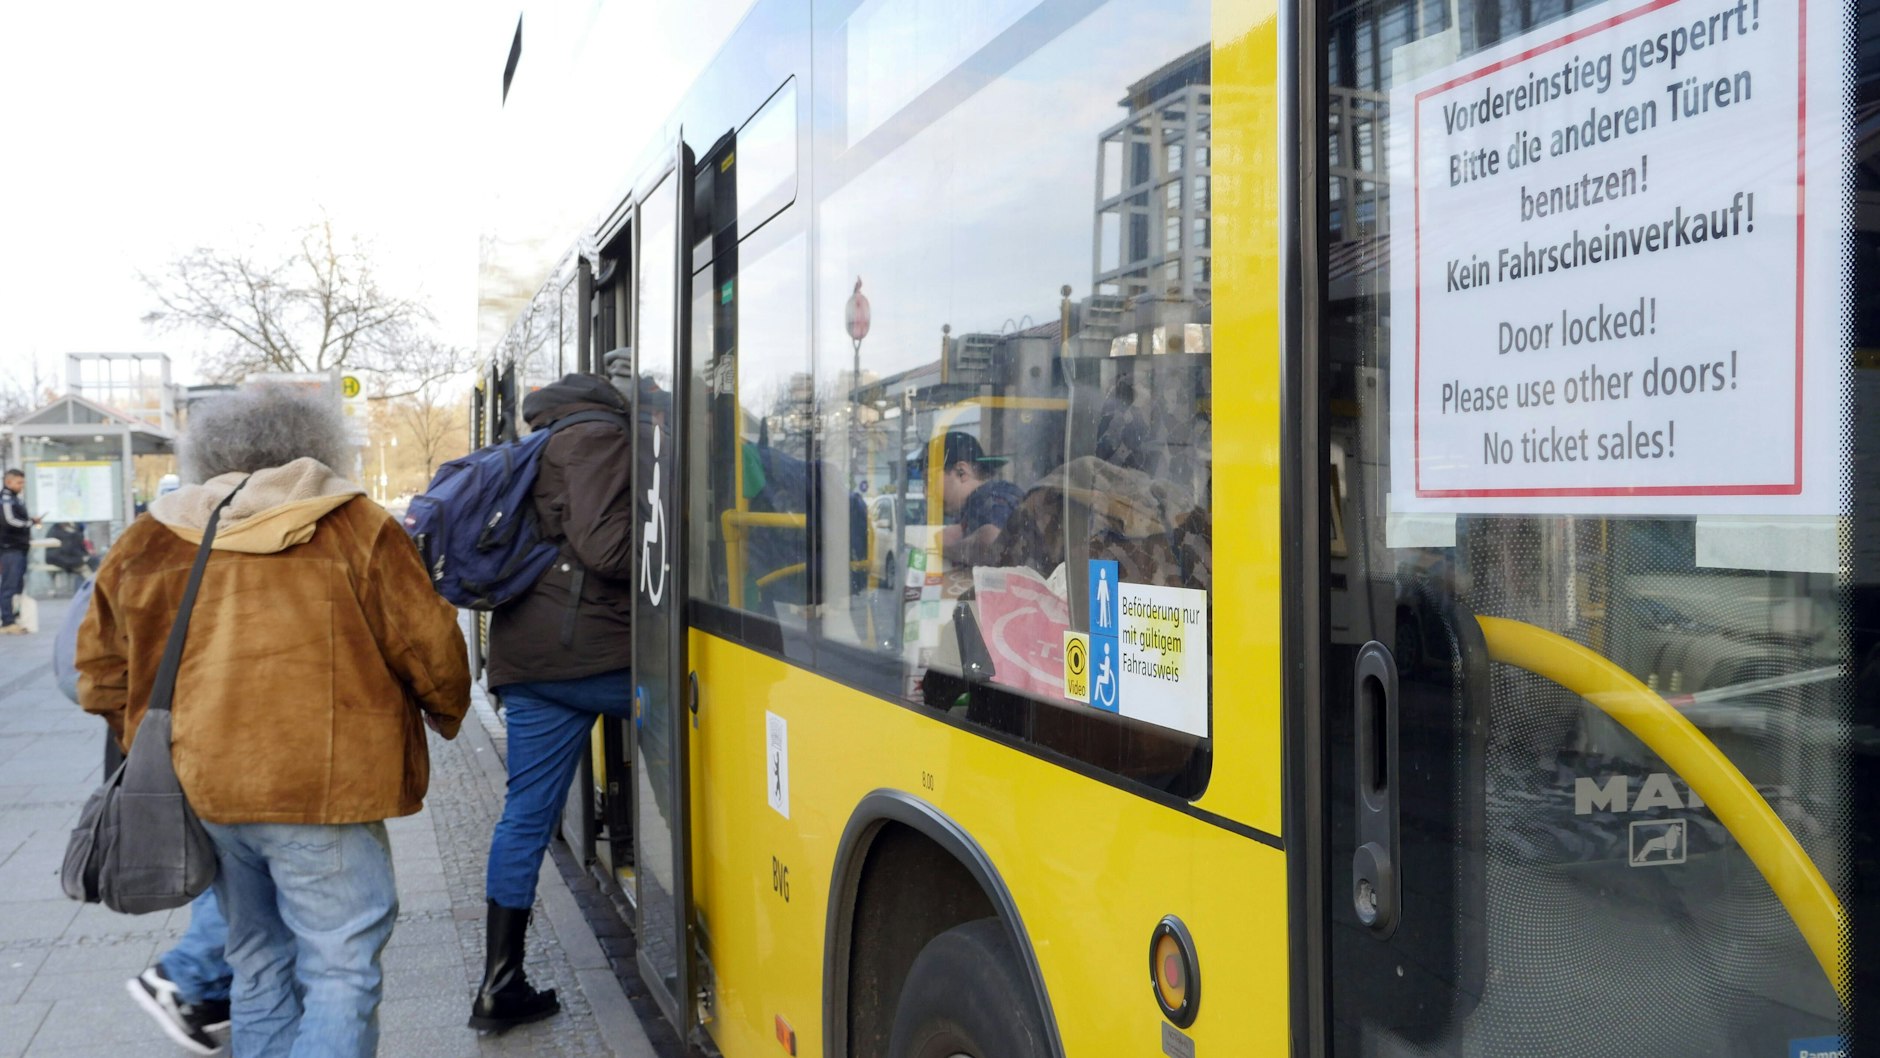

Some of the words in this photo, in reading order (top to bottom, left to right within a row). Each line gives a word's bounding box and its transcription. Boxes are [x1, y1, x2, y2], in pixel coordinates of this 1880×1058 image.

[1443, 52, 1612, 136] Vordereinstieg
[1621, 0, 1760, 86] gesperrt!
[1450, 146, 1500, 188] Bitte
[1507, 131, 1541, 170] die
[1550, 100, 1657, 156] anderen
[1667, 70, 1752, 122] Türen
[1520, 155, 1648, 222] benutzen!
[1447, 253, 1490, 293] Kein
[1498, 192, 1755, 283] Fahrscheinverkauf!
[1498, 321, 1553, 355] Door
[1562, 297, 1657, 346] locked!
[1442, 380, 1508, 415] Please
[1517, 379, 1555, 410] use
[1564, 363, 1632, 404] other
[1642, 350, 1738, 397] doors!
[1483, 432, 1513, 465] No
[1521, 427, 1588, 464] ticket
[1597, 420, 1675, 461] sales!
[1122, 596, 1180, 628] Beförderung
[1183, 608, 1200, 625] nur
[1122, 626, 1137, 646] mit
[1140, 628, 1182, 656] gültigem
[1068, 679, 1086, 697] Video
[1123, 653, 1179, 683] Fahrausweis
[772, 855, 790, 903] BVG
